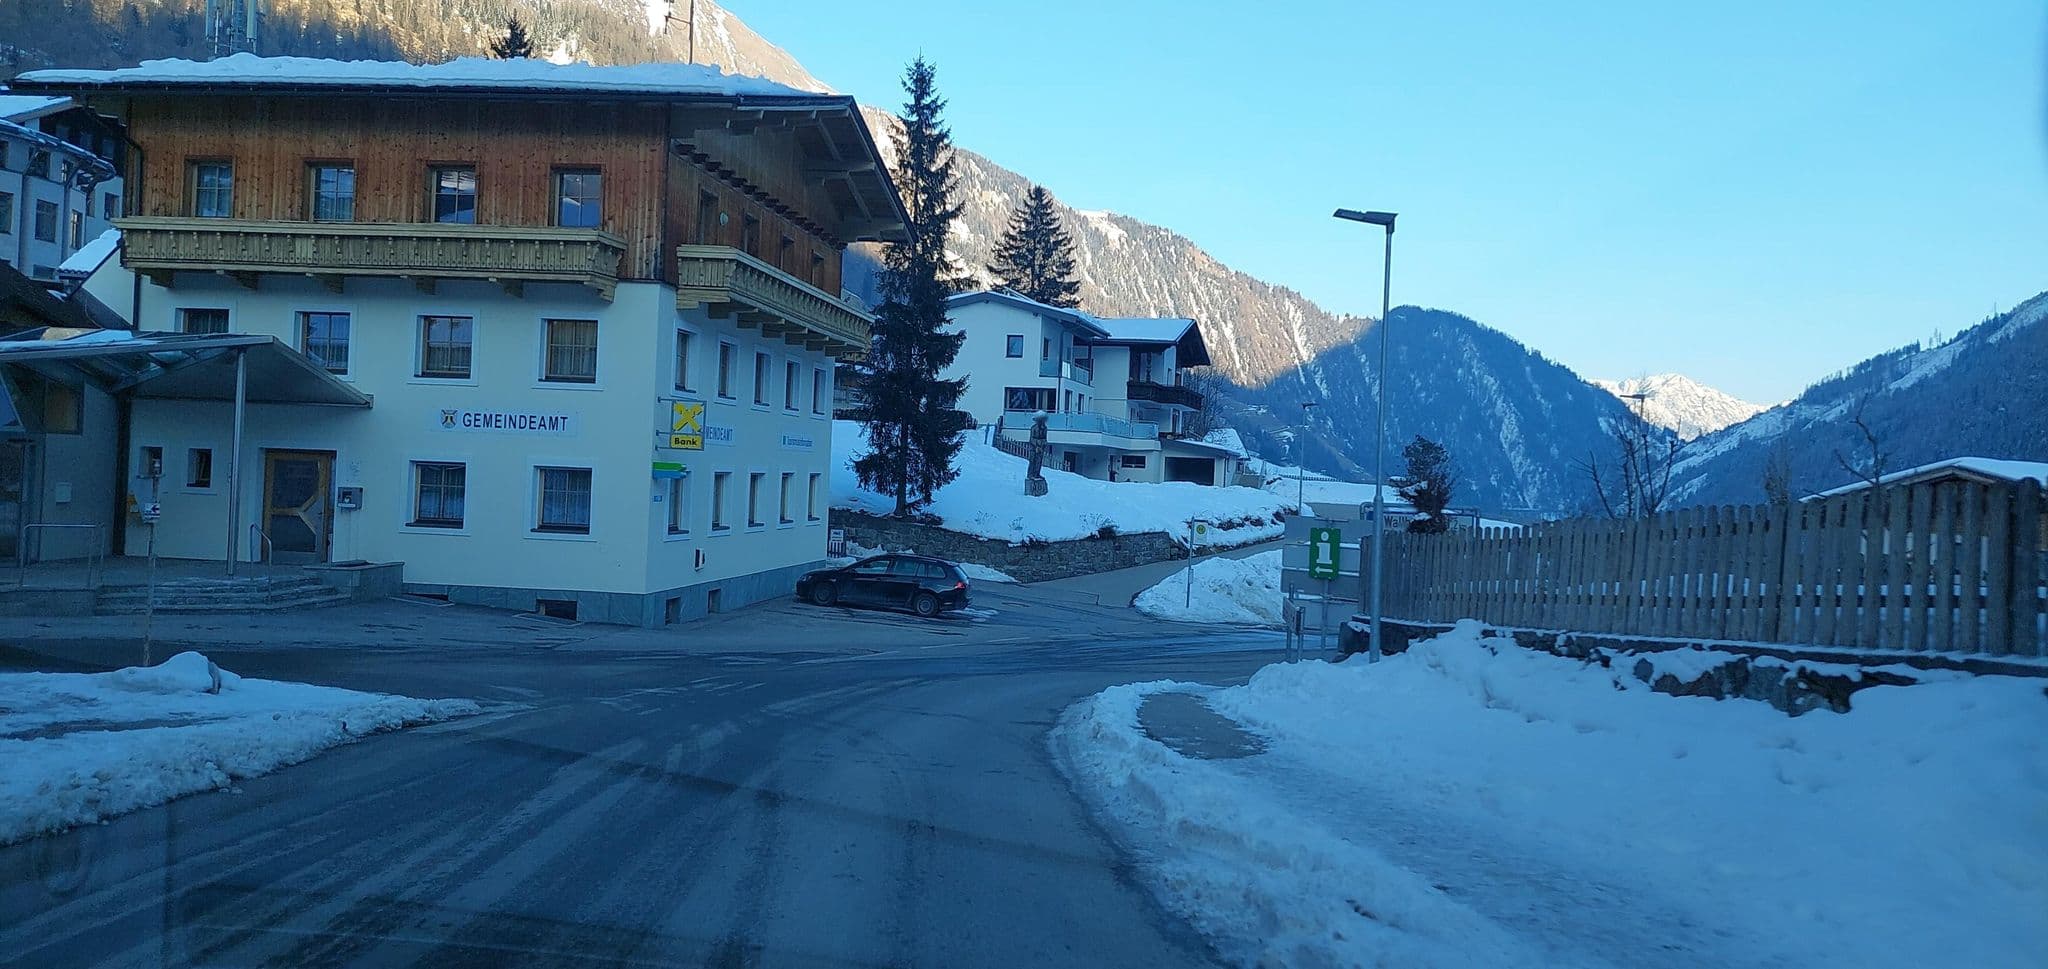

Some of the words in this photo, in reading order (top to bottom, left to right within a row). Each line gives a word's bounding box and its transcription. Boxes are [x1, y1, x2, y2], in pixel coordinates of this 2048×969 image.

[462, 412, 568, 431] GEMEINDEAMT
[705, 426, 733, 441] MEINDEAMT
[674, 437, 698, 446] Bank
